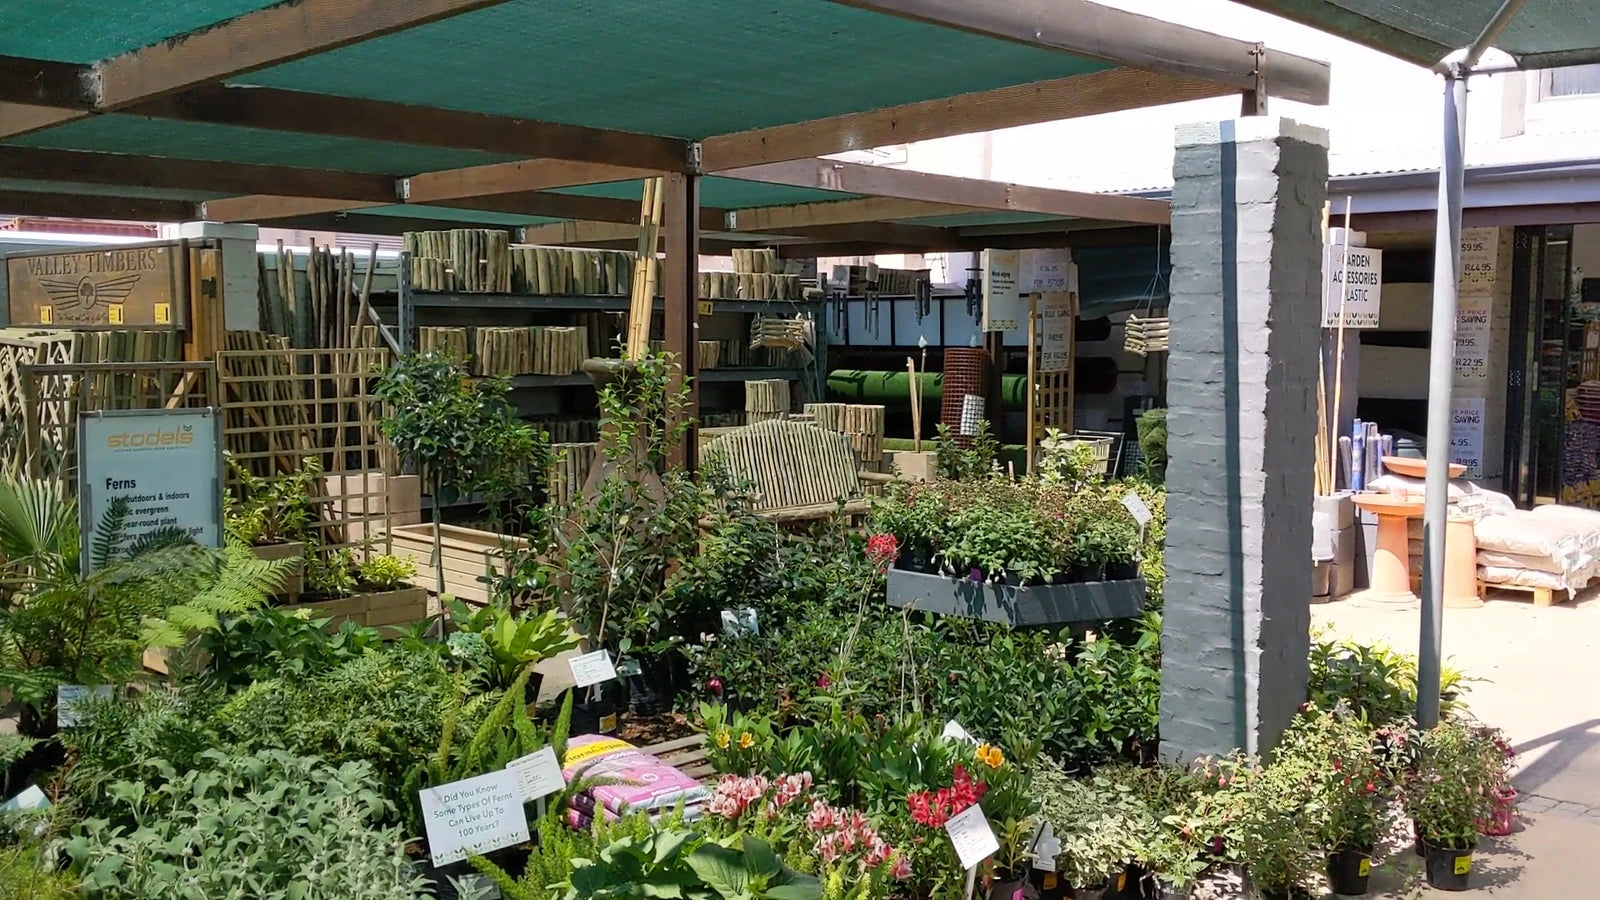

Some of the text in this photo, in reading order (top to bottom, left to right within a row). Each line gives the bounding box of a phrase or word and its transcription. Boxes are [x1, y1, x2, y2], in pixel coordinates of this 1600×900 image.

[27, 250, 156, 276] VALLEY TIMBERS
[1342, 253, 1370, 267] ARDEN
[1333, 271, 1378, 285] ACESSORIES
[1344, 289, 1368, 302] LASTIC
[1461, 315, 1487, 324] SAVING
[1454, 415, 1480, 424] SAVING
[107, 426, 194, 448] stodels
[106, 478, 136, 490] Ferns
[158, 493, 163, 501] &
[165, 492, 190, 501] indoors
[135, 506, 168, 516] evergreen
[160, 517, 177, 527] plant
[188, 527, 204, 538] light
[444, 784, 498, 804] Did You Know
[433, 792, 513, 819] Some Types Of Ferns
[448, 807, 504, 828] Can Live Up To
[458, 820, 500, 838] 100 Years?
